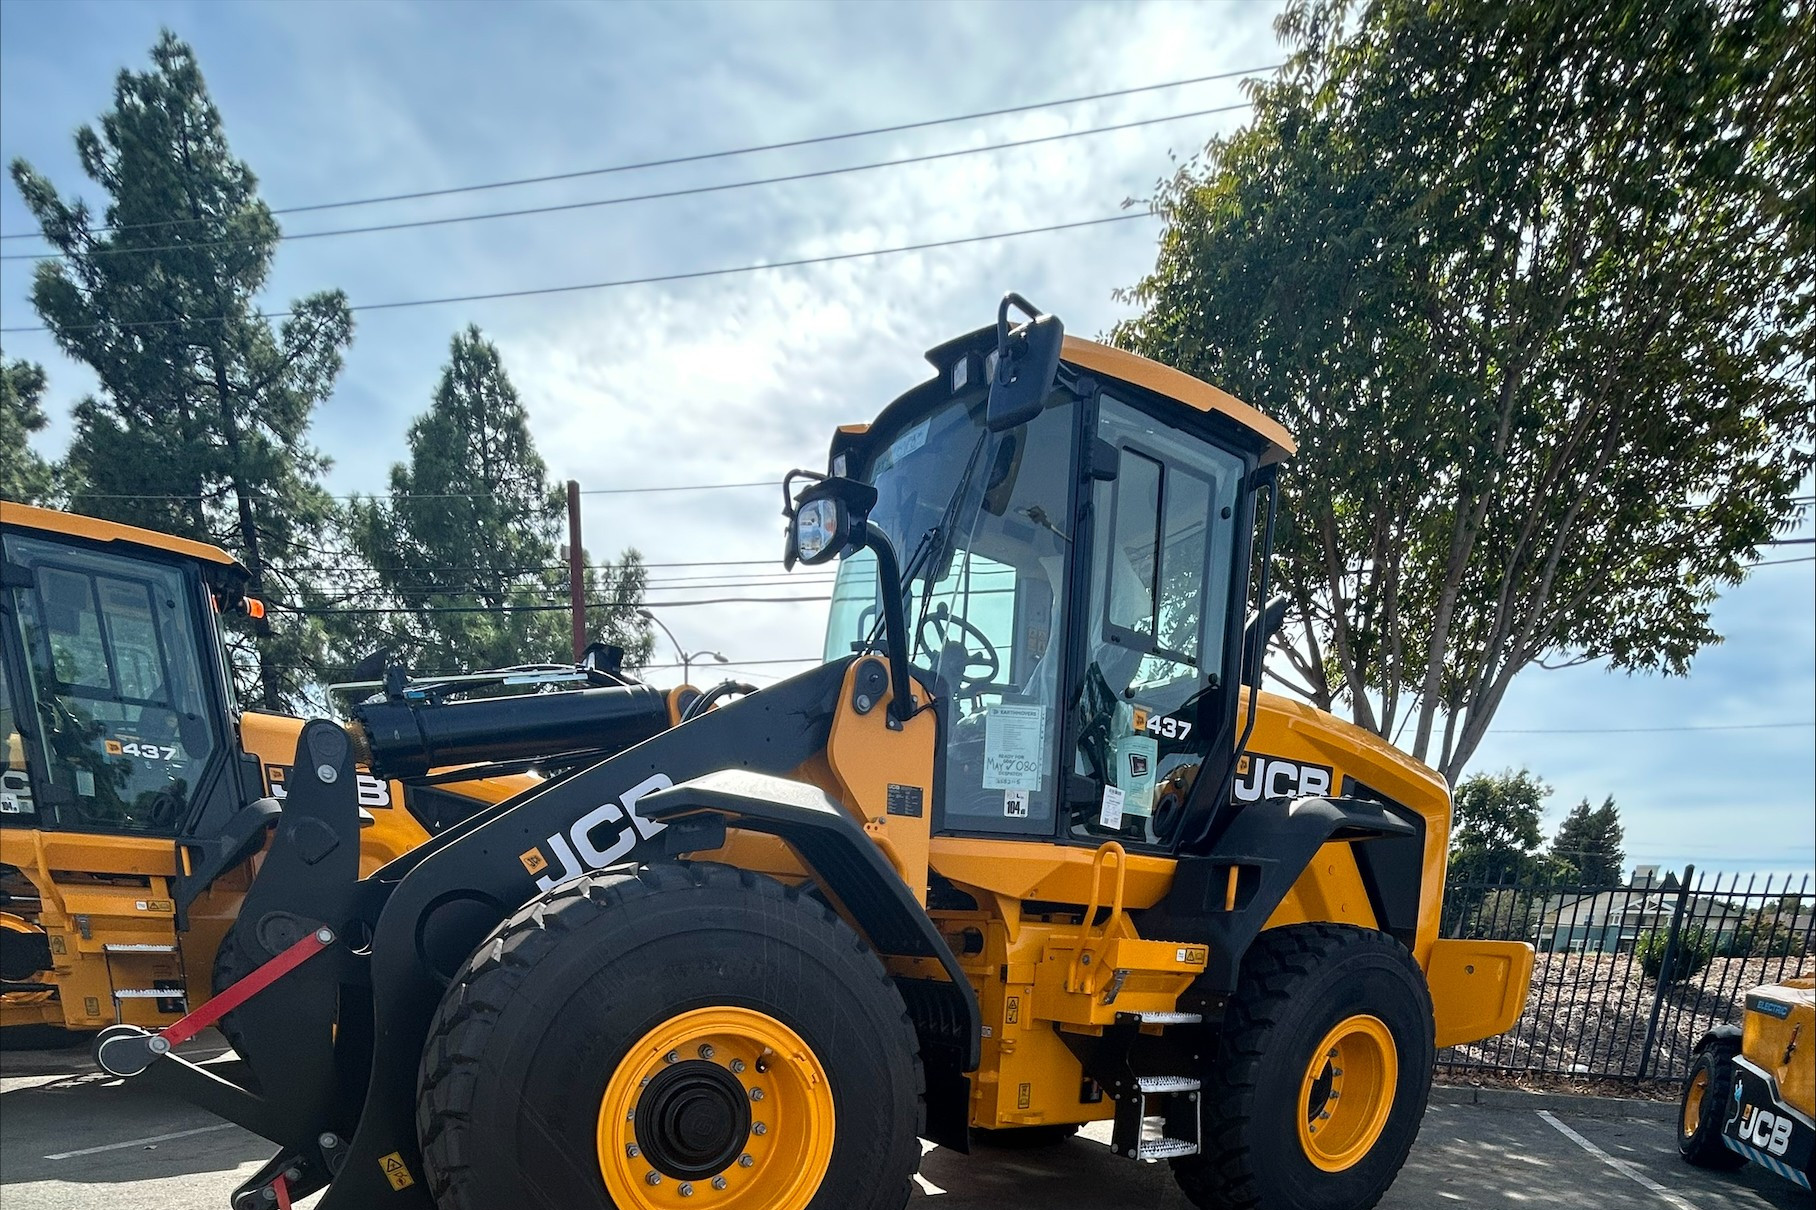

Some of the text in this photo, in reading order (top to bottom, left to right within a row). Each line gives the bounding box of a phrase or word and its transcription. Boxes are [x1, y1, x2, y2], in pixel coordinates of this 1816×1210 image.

[1146, 714, 1192, 740] 437
[122, 742, 177, 760] 437
[1016, 760, 1037, 772] 080
[1234, 757, 1330, 801] JCB
[1007, 800, 1021, 815] 104
[1756, 999, 1788, 1016] ELECTRIC
[1738, 1106, 1793, 1157] JCB
